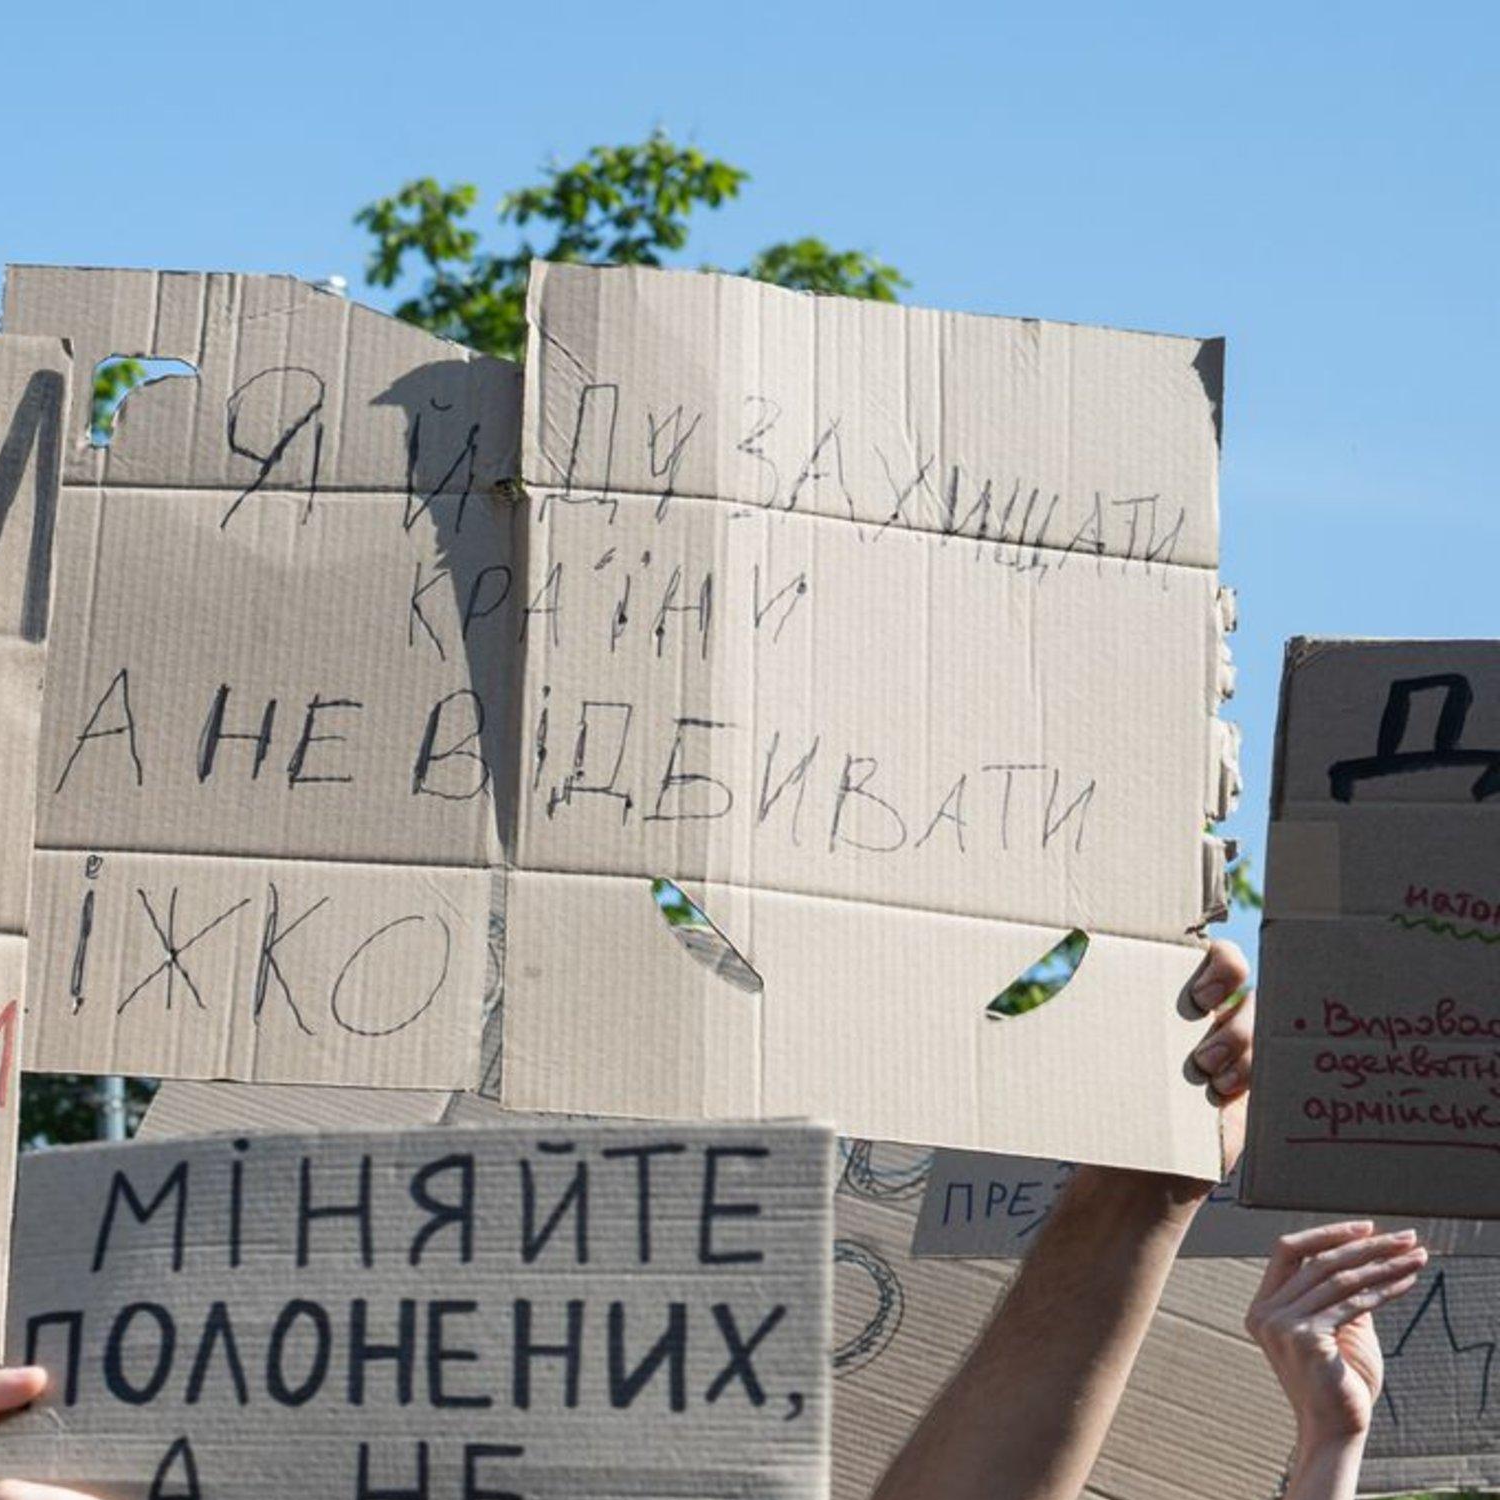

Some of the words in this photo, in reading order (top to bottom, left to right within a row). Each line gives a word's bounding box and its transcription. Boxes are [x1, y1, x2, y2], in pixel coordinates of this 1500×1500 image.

[220, 366, 325, 529] Я
[55, 668, 143, 794] А
[198, 684, 364, 790] НЕ
[92, 1137, 770, 1273] МІНЯЙТЕ
[942, 1180, 1062, 1238] ПРЕ
[23, 1299, 806, 1421] ПОЛОНЕНИХ,
